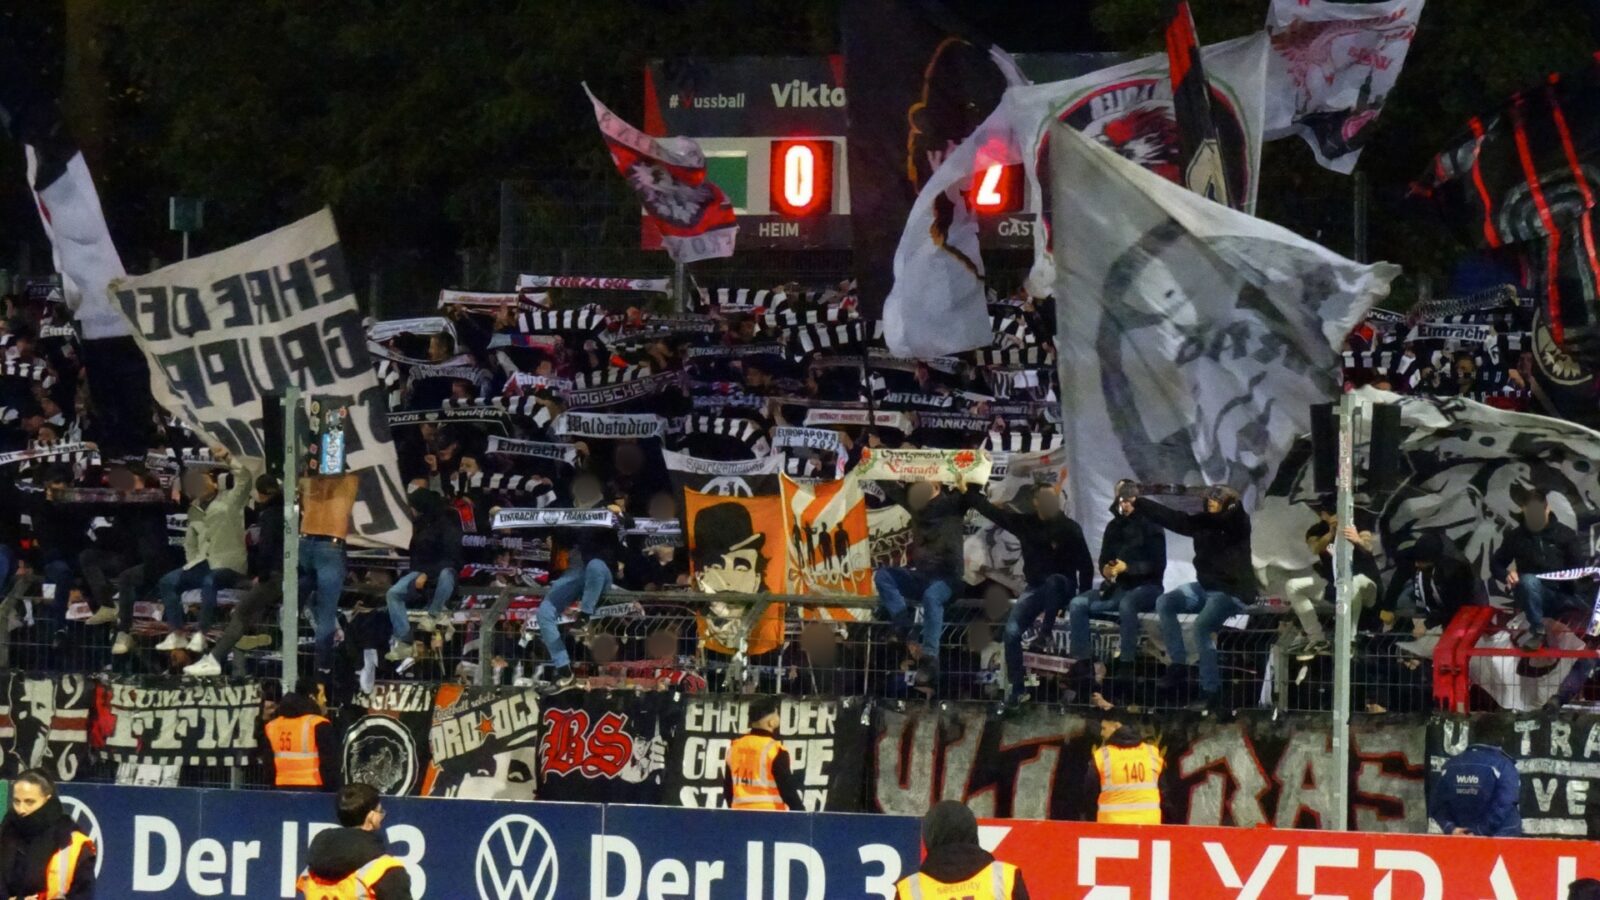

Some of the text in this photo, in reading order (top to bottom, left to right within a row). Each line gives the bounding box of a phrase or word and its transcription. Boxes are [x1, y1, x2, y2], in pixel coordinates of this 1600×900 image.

[784, 145, 814, 207] 0
[759, 222, 799, 238] HEIM
[1418, 323, 1490, 341] Eintracht
[569, 382, 644, 407] MAGISCHE
[566, 413, 658, 436] Waldstadion
[497, 439, 567, 460] Eintracht
[499, 511, 609, 523] EINTRACHT FRANKFURT
[779, 700, 837, 735] DER
[1123, 762, 1145, 783] 140
[132, 814, 260, 896] Der
[590, 834, 724, 900] Der
[936, 881, 981, 895] security
